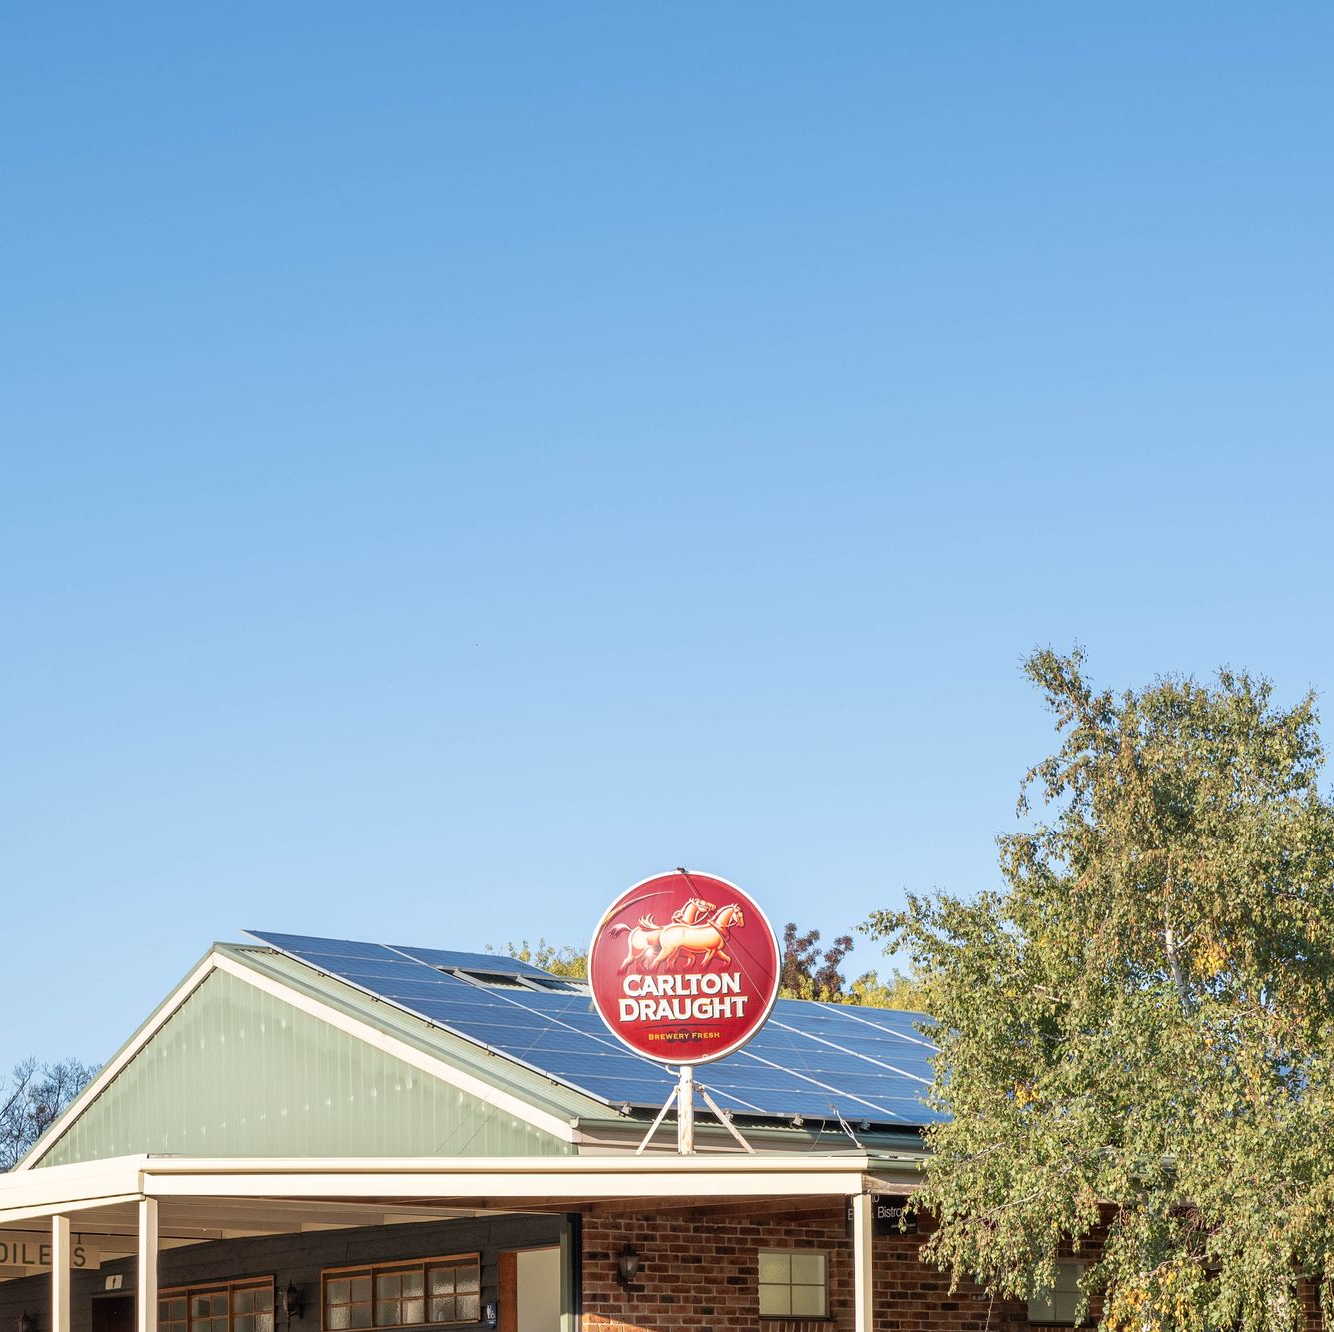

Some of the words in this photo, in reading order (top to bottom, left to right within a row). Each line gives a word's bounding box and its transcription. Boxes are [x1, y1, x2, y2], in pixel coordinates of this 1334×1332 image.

[623, 972, 742, 998] CARLTON
[619, 996, 748, 1022] DRAUGHT
[648, 1032, 689, 1041] BREWERY
[691, 1031, 720, 1039] FRESH
[877, 1206, 902, 1219] Bistro
